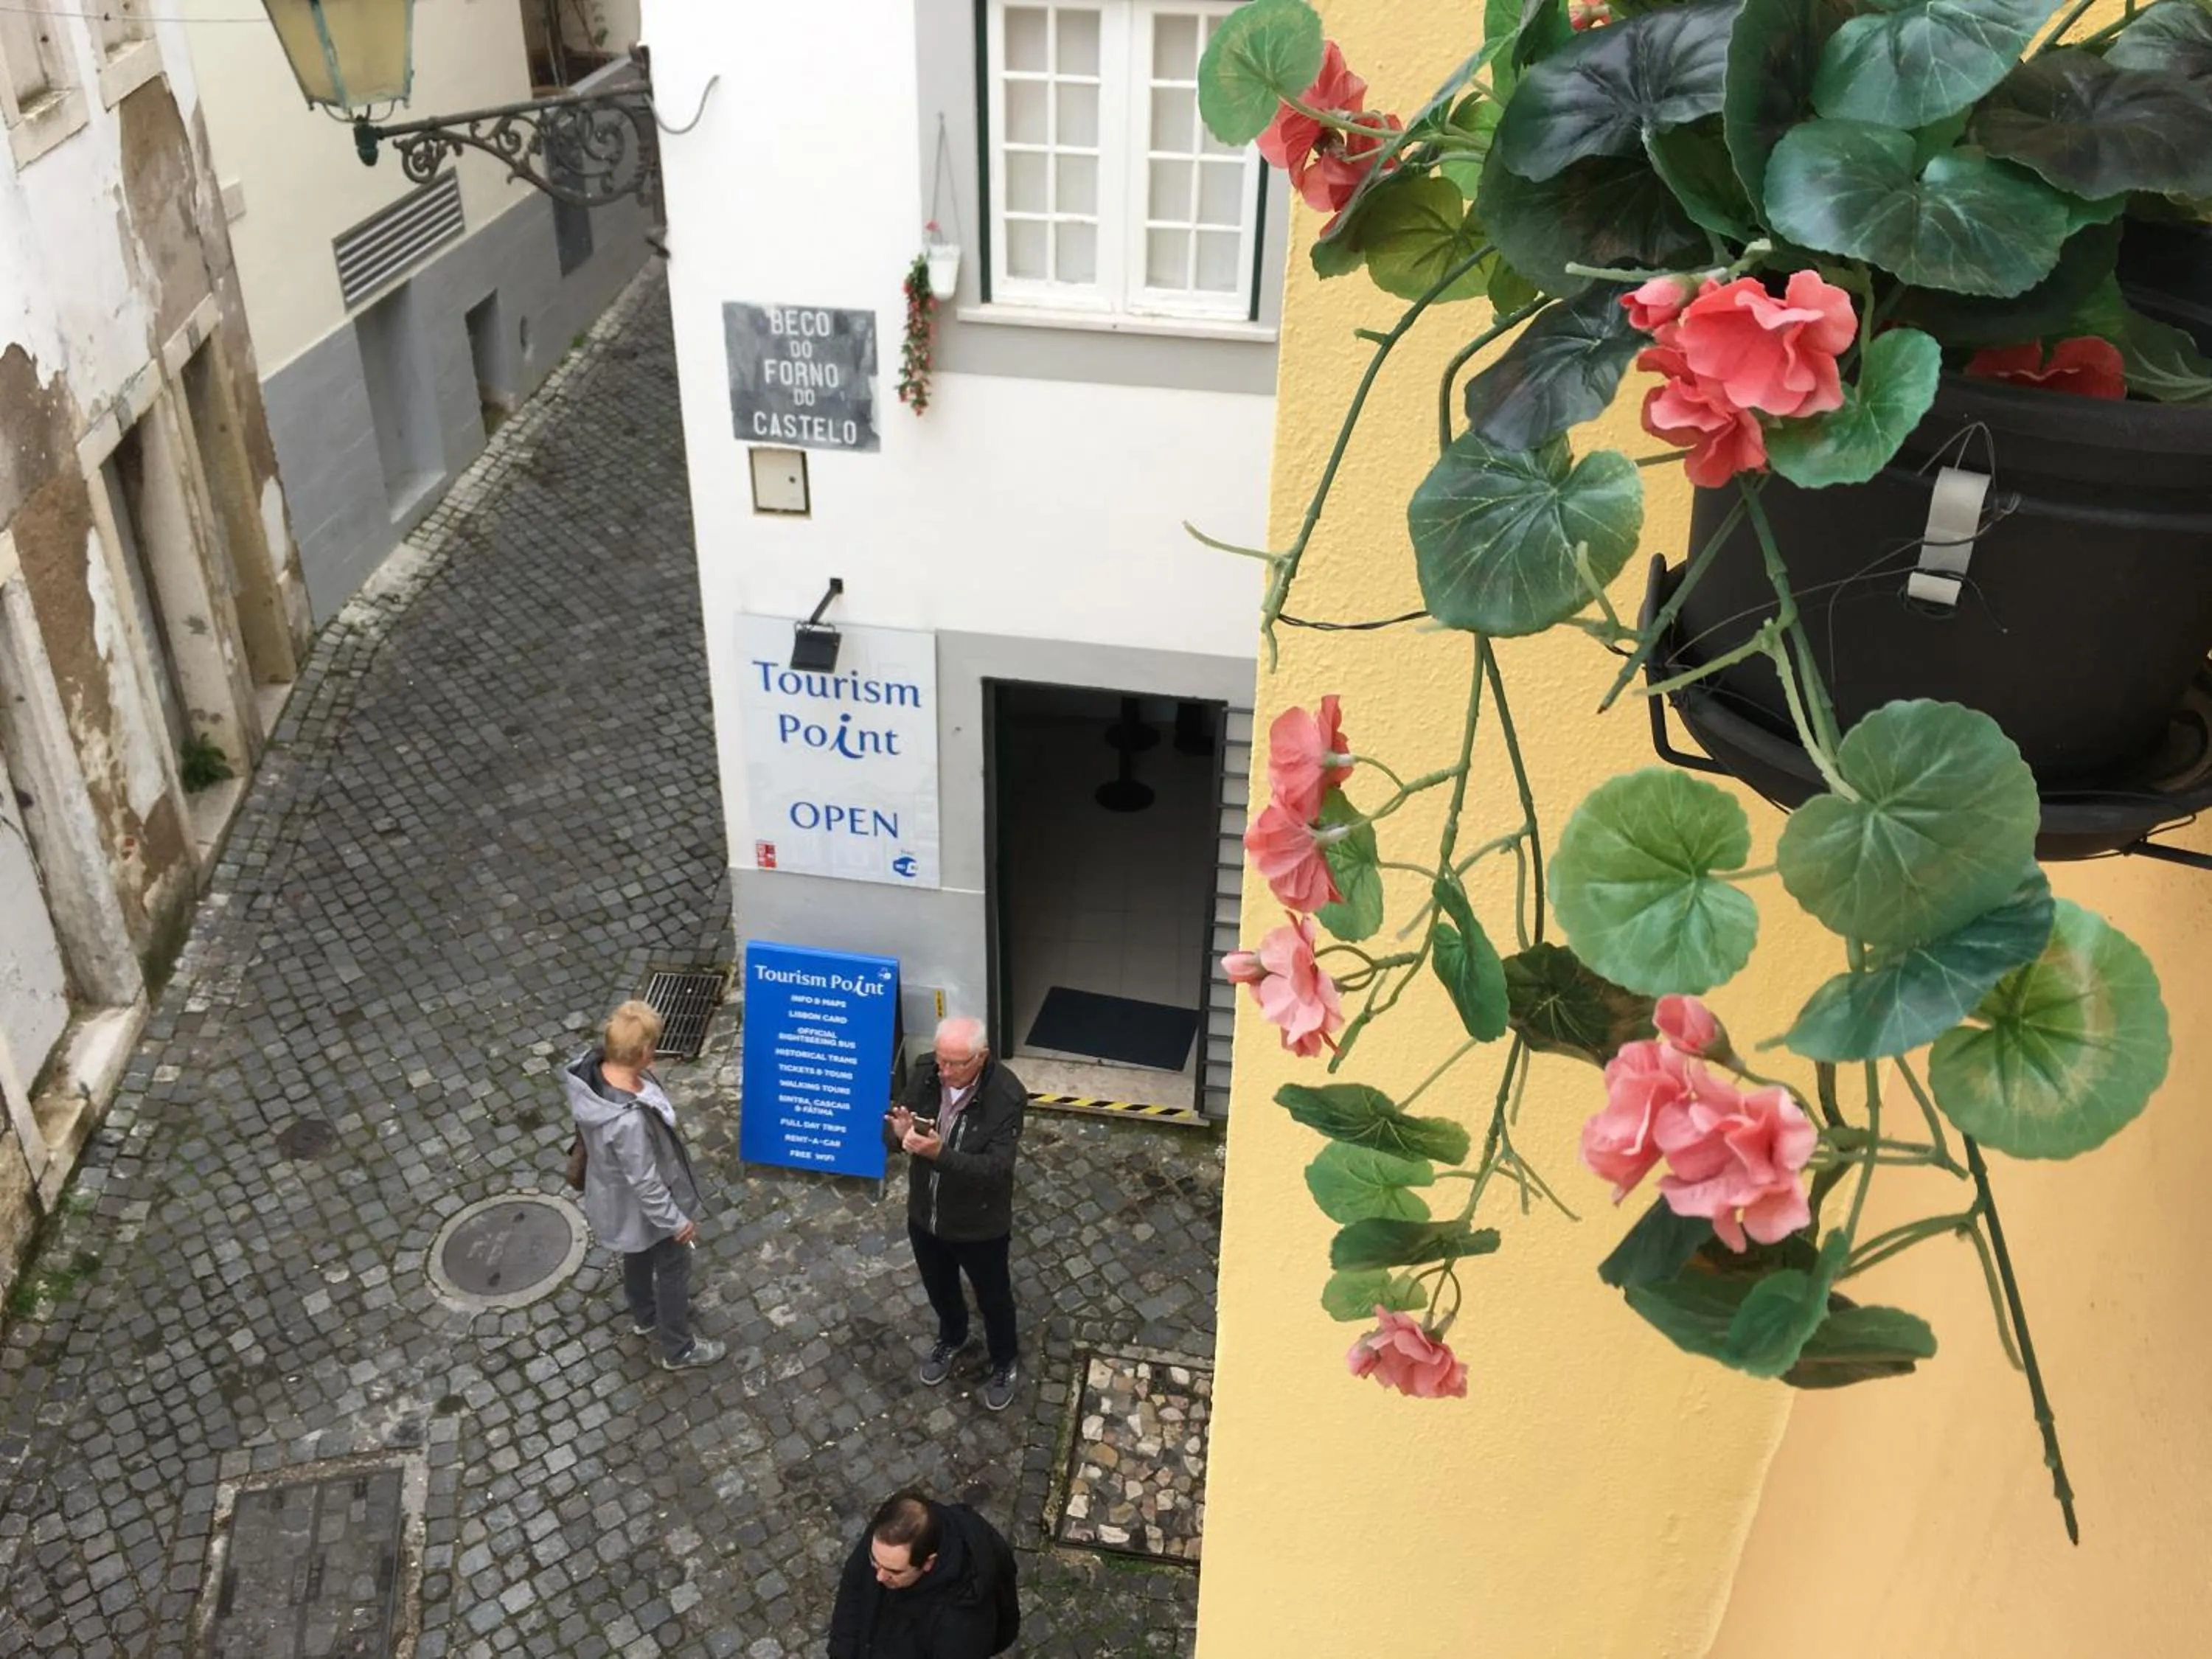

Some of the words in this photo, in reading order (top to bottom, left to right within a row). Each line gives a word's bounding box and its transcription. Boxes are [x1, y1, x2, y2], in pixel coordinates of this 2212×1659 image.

[771, 309, 830, 337] BECO
[790, 341, 813, 358] DO
[764, 359, 839, 389] FORNO
[793, 389, 815, 406] DO
[753, 411, 858, 445] CASTELO
[752, 661, 921, 708] Tourism
[779, 713, 901, 759] Point
[790, 801, 899, 838] OPEN
[754, 964, 827, 988] Tourism
[830, 975, 885, 997] Point
[790, 995, 813, 1004] INFO
[821, 998, 846, 1008] MAPS
[787, 1009, 821, 1020] LISBON
[822, 1015, 847, 1024] CARD
[779, 1032, 837, 1046] SIGHTSEEING
[838, 1040, 856, 1049] BUS
[797, 1027, 838, 1039] OFFICIAL
[775, 1048, 827, 1062] HISTORICAL
[828, 1054, 858, 1065] TRAMS
[779, 1063, 815, 1074] TICKETS
[824, 1069, 853, 1080] TOURS
[779, 1079, 820, 1091] WALKING
[822, 1085, 850, 1095] TOURS
[813, 1099, 850, 1110] CASCAIS
[779, 1118, 802, 1127] FULL
[804, 1121, 820, 1130] DAY
[822, 1124, 846, 1133] TRIPS
[784, 1133, 841, 1147] RENT-A-CAR
[790, 1150, 812, 1158] FREE
